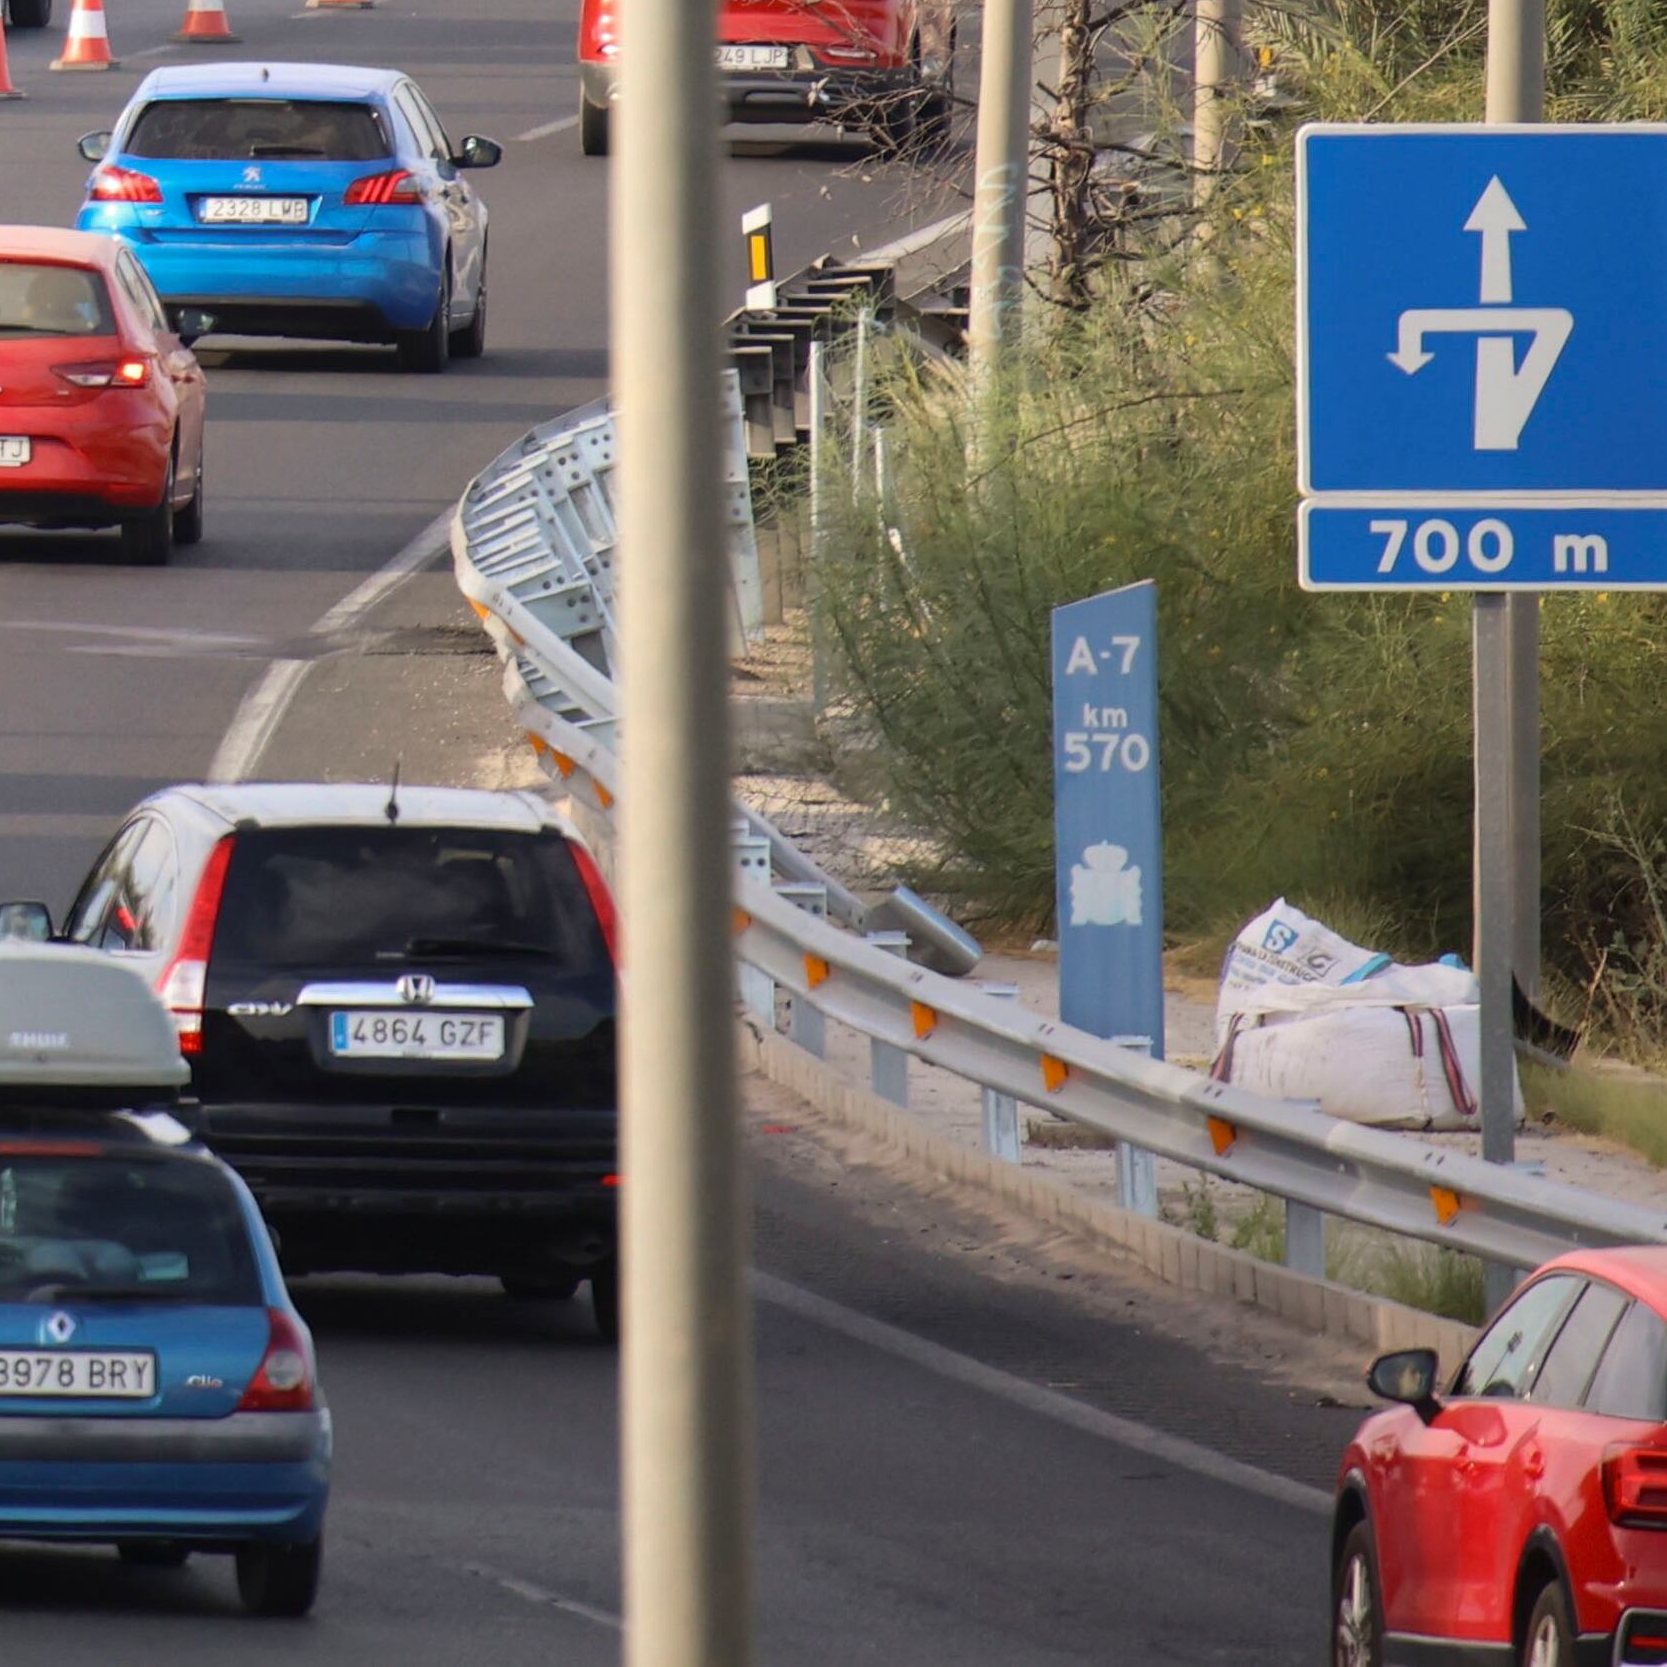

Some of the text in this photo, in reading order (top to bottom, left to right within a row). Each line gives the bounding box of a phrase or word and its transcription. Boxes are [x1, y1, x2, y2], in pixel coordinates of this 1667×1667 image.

[751, 47, 784, 64] LJP
[213, 200, 306, 218] 2328 LWB
[1370, 518, 1609, 574] 700 m
[1065, 636, 1141, 676] A-7
[1083, 702, 1129, 728] km
[1064, 733, 1150, 773] 570
[353, 1017, 495, 1047] 4864 GZF
[88, 1359, 150, 1389] BRY
